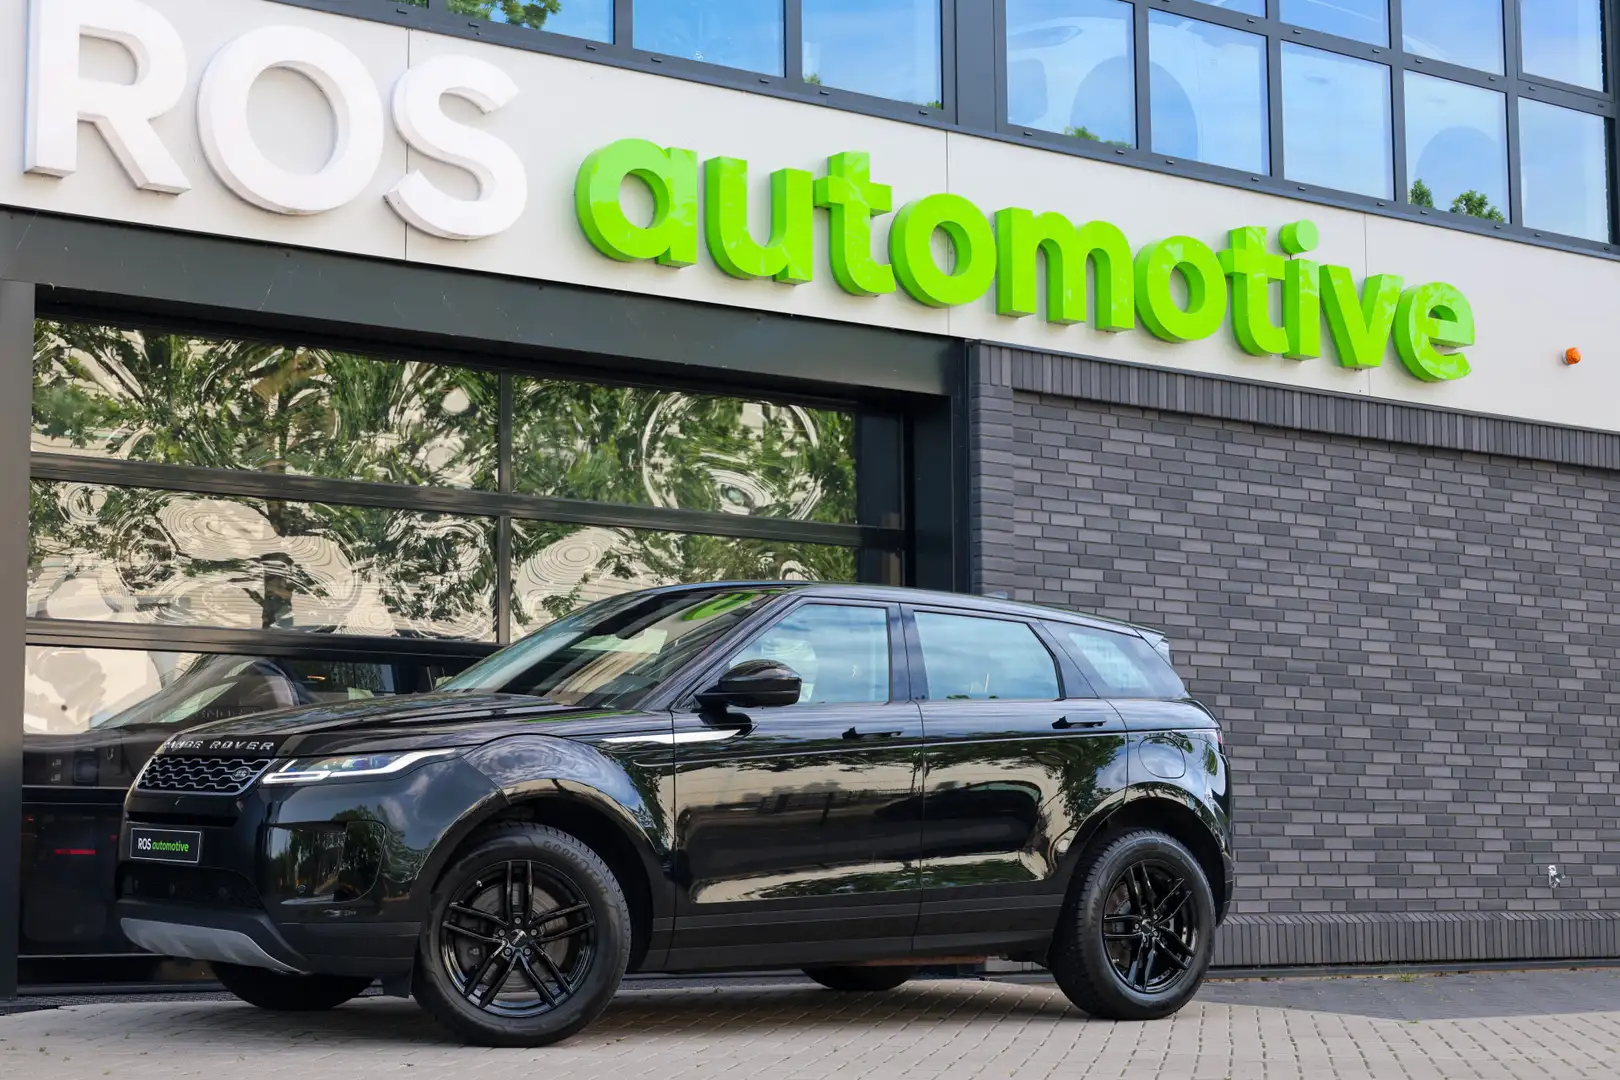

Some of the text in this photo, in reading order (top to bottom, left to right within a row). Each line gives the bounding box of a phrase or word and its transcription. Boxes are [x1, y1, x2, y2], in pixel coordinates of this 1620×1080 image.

[24, 0, 1475, 382] ROS automotive
[209, 740, 274, 750] ROVER
[138, 838, 189, 852] ROS automotive
